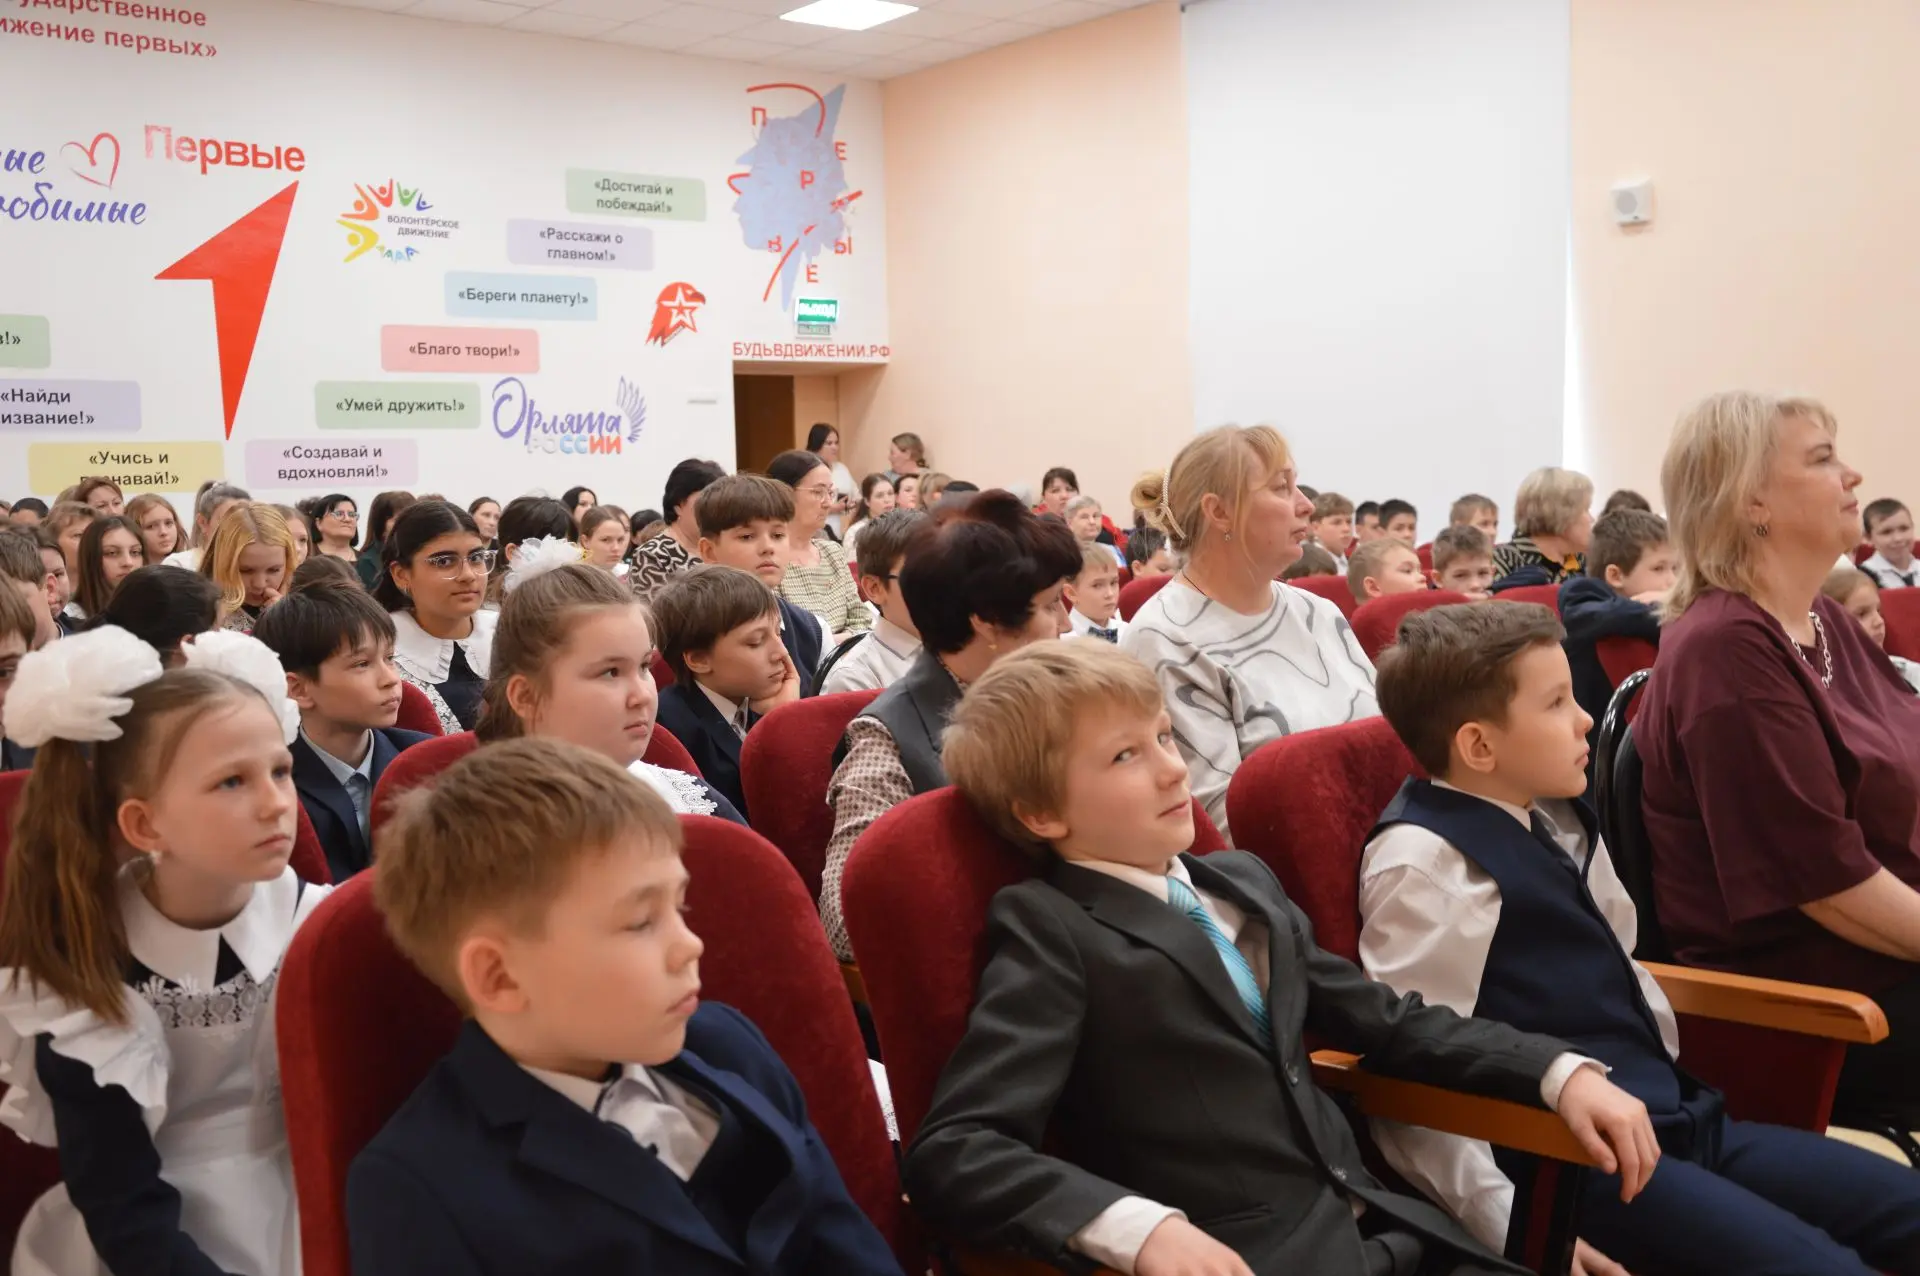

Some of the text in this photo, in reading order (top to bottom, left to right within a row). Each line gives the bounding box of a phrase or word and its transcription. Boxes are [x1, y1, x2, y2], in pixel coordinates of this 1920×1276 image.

[104, 30, 217, 57] первых»
[144, 124, 305, 175] Первые
[594, 178, 673, 195] «Достигай и
[596, 198, 672, 213] побеждай!»
[397, 227, 450, 239] ДВИЖЕНИЕ
[540, 227, 624, 244] «Расскажи о
[547, 248, 616, 261] главном!»
[458, 288, 588, 307] «Береги планету!»
[409, 342, 520, 359] «Благо твори!»
[0, 388, 71, 404] «Найди
[336, 398, 465, 414] «Умей дружить!»
[492, 376, 621, 446] Орлята
[89, 451, 169, 465] «Учись и
[283, 446, 382, 460] «Создавай и
[80, 472, 179, 485] навай!»
[278, 465, 388, 480] вдохновляй!»
